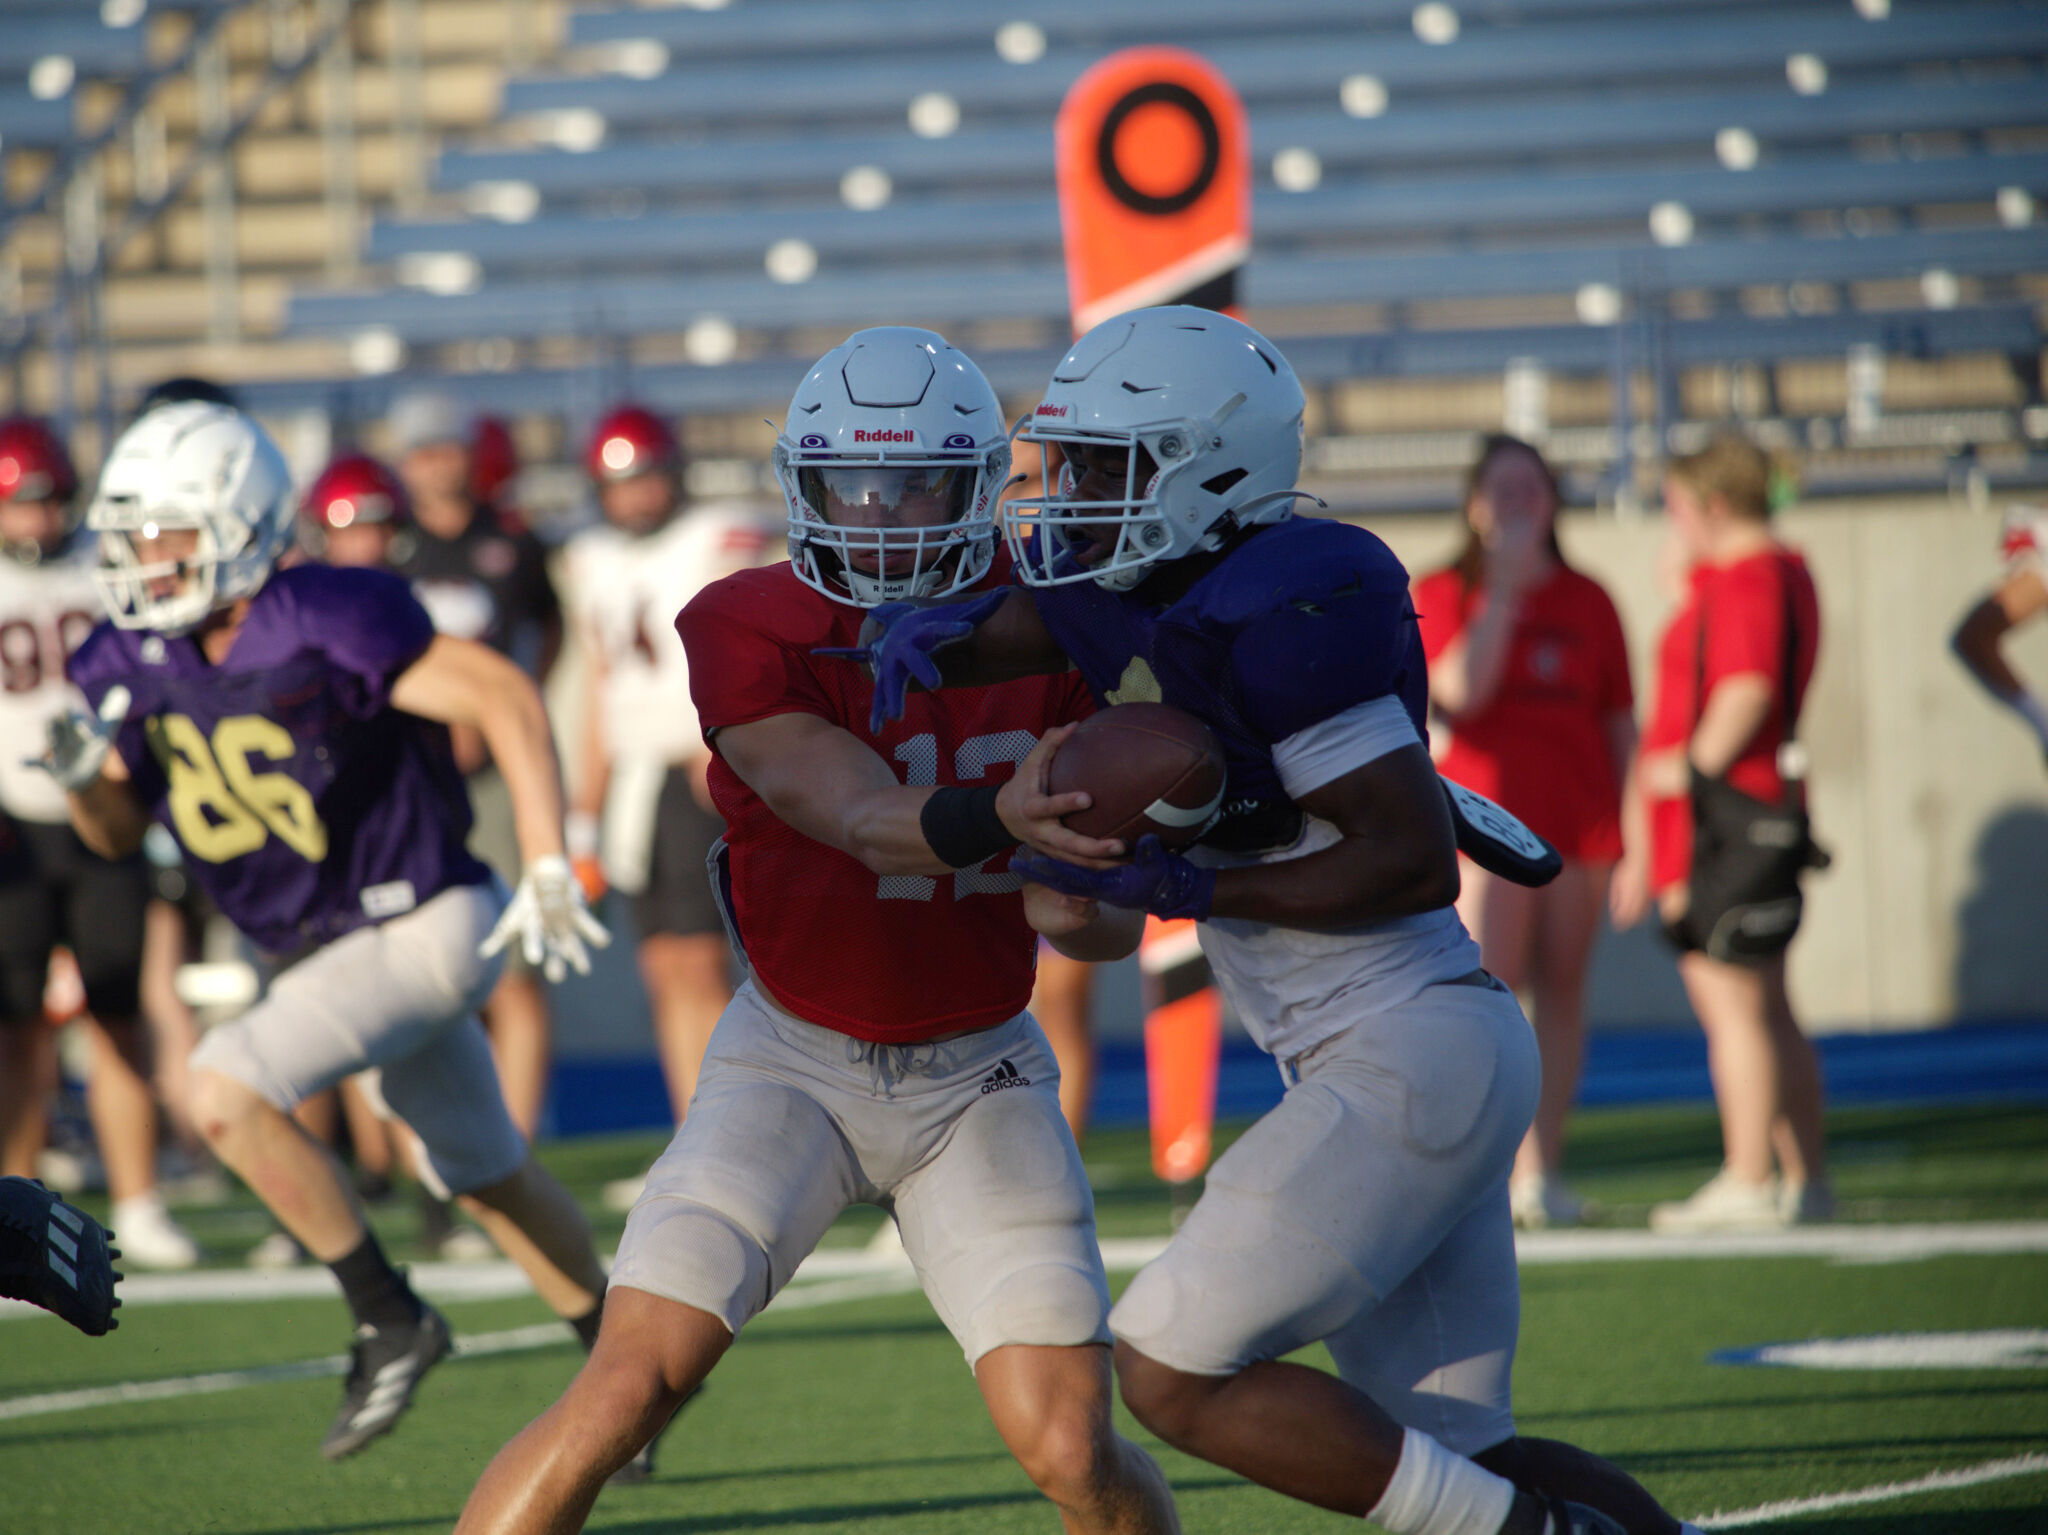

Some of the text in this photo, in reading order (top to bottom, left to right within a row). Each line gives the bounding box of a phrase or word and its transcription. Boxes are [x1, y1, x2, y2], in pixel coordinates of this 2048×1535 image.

[855, 429, 914, 442] Riddell
[873, 585, 904, 593] Rdell
[145, 713, 328, 863] 86
[877, 729, 1042, 902] 12
[981, 1076, 1030, 1095] adidas
